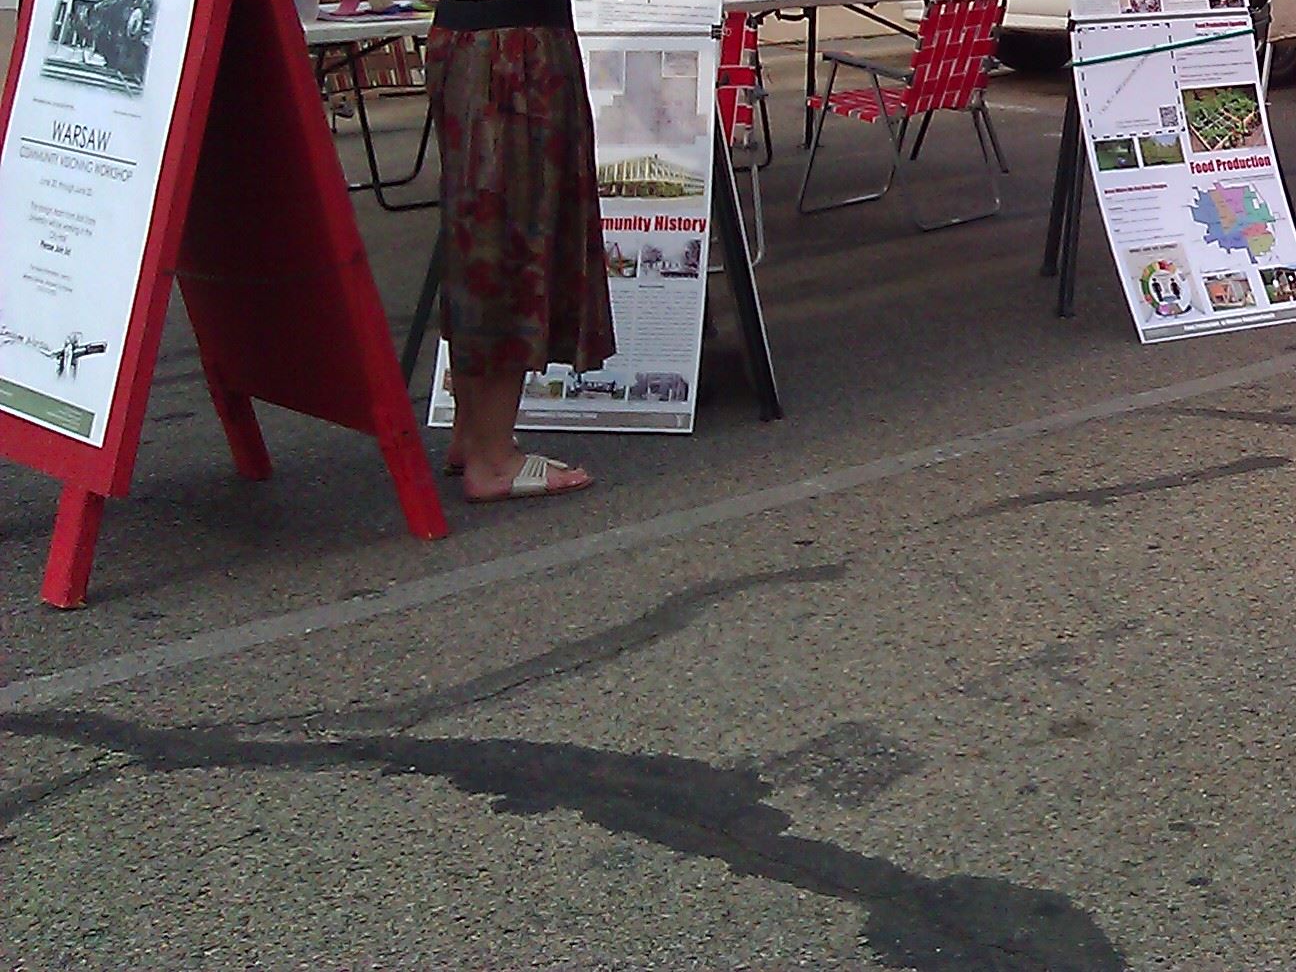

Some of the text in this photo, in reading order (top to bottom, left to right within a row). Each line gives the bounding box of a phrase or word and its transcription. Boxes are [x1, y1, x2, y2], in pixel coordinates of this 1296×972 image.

[52, 119, 112, 152] WARSAW
[20, 145, 59, 165] COMMUNITY
[94, 163, 134, 183] WORKSHOP
[1190, 154, 1272, 174] Food Production
[601, 214, 707, 233] munity History
